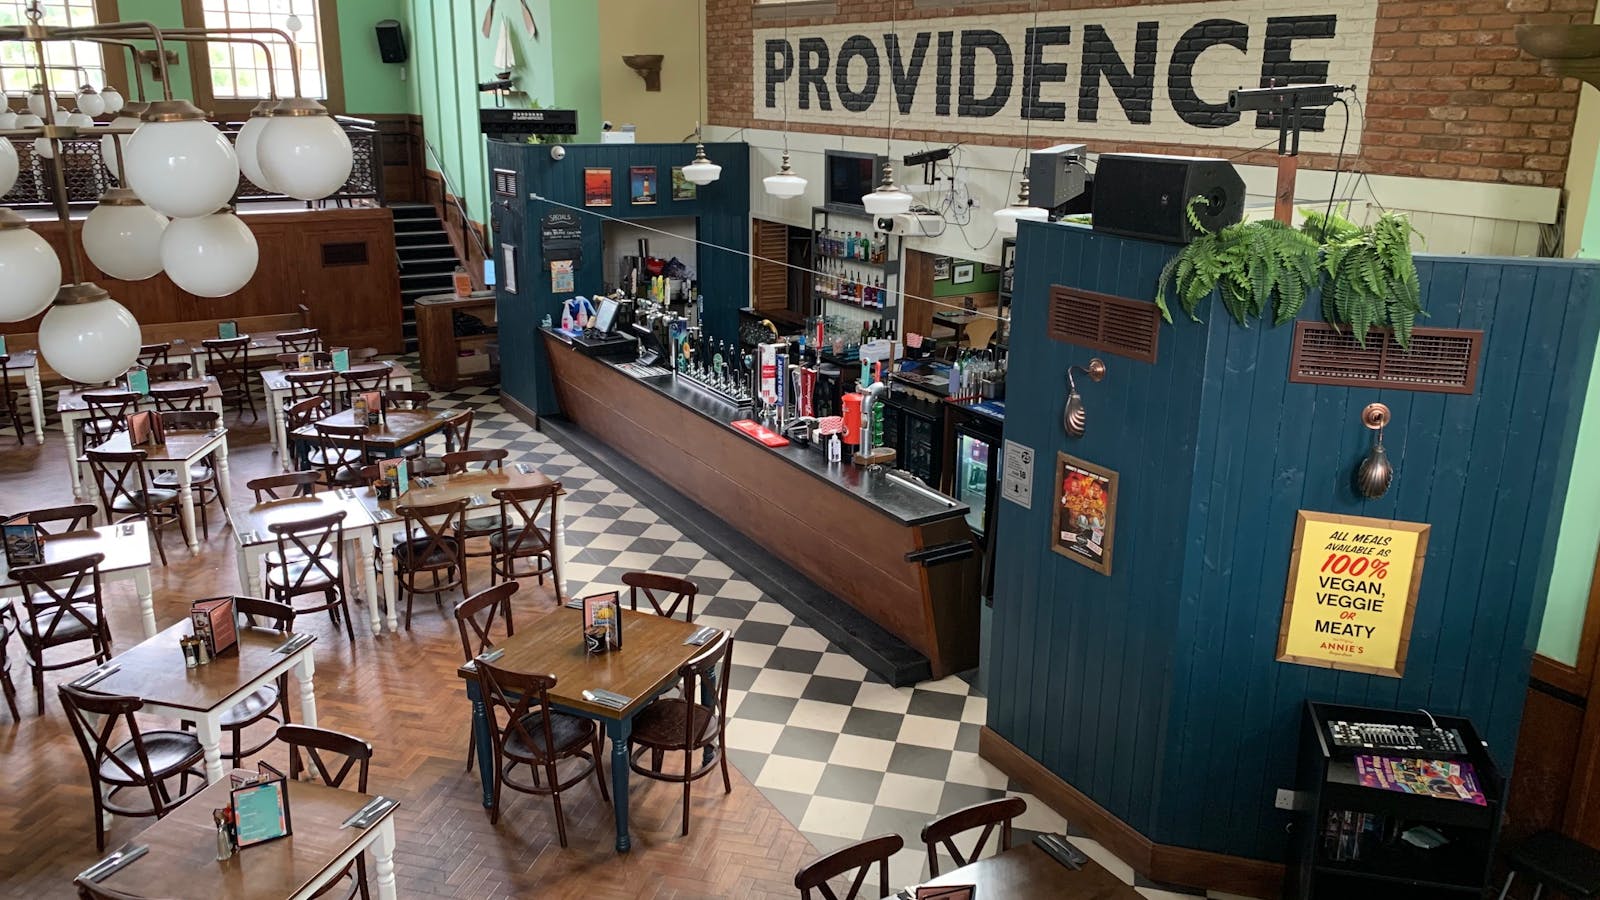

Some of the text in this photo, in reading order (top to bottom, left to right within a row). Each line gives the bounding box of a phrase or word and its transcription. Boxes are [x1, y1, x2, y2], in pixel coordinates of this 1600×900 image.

[763, 14, 1337, 132] PROVIDENCE
[1329, 531, 1392, 546] ALL MEALS
[1324, 542, 1391, 557] AVAILABLE AS
[1321, 553, 1390, 579] 100%
[1319, 575, 1385, 598] VEGAN,
[1316, 592, 1385, 612] VEGGIE
[1339, 611, 1356, 620] OR
[1315, 619, 1376, 638] MEATY
[1319, 641, 1364, 654] ANNIE'S
